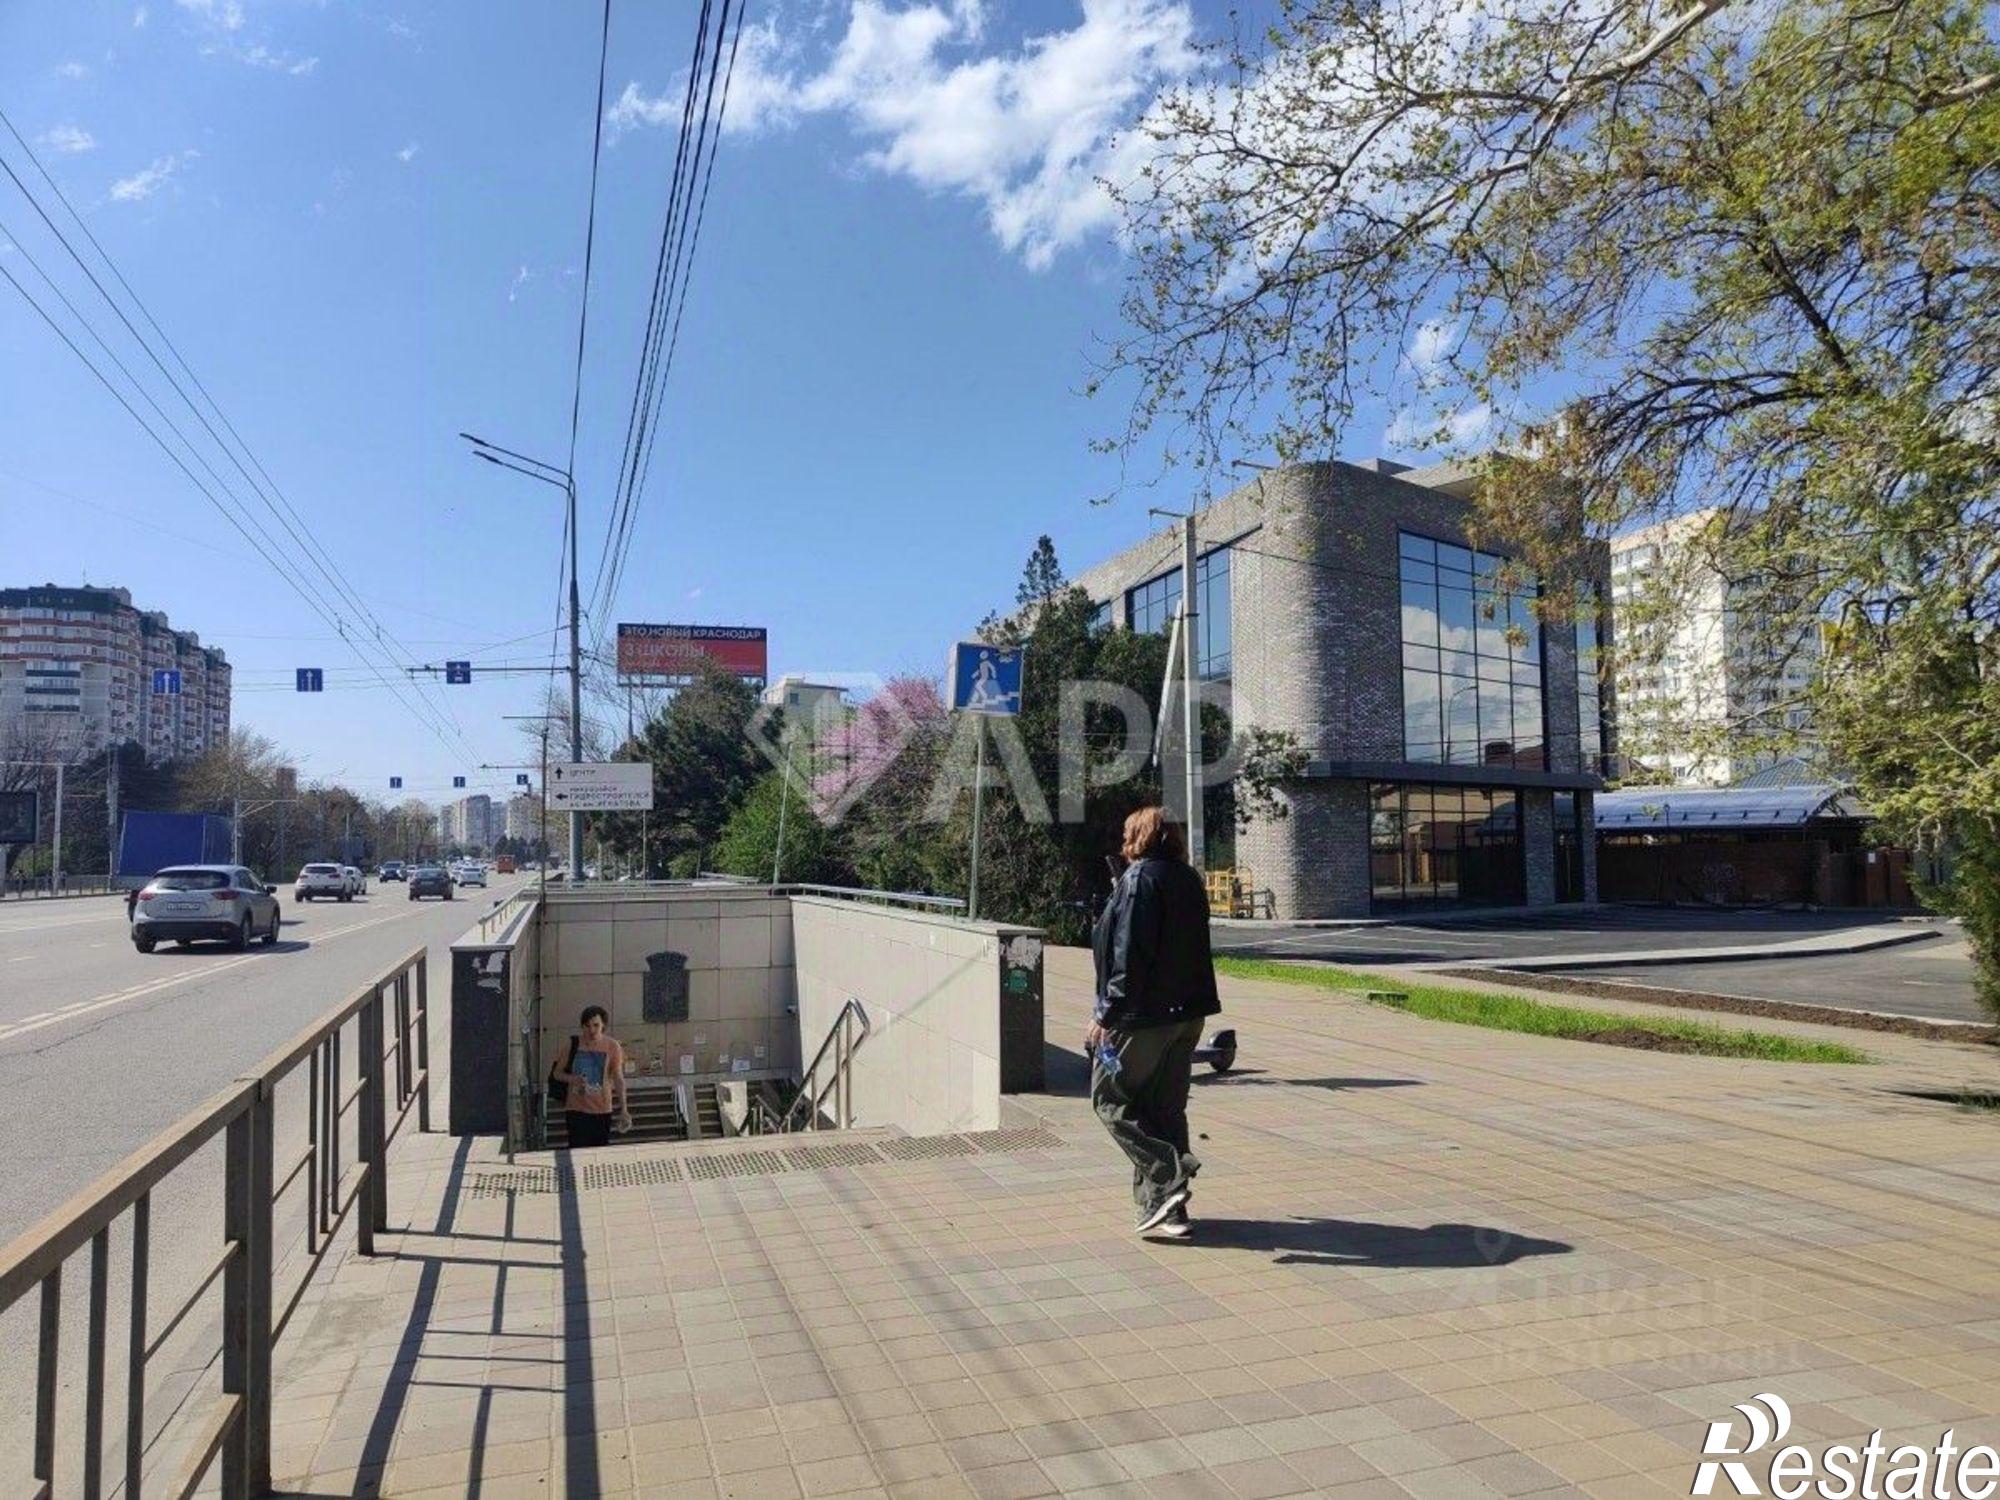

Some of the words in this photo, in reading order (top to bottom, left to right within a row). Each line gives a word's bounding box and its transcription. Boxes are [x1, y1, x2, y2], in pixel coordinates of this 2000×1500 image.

[624, 626, 647, 637] ЭТО
[649, 626, 691, 638] НОВЫЙ
[693, 628, 761, 640] КРАСНОДАР
